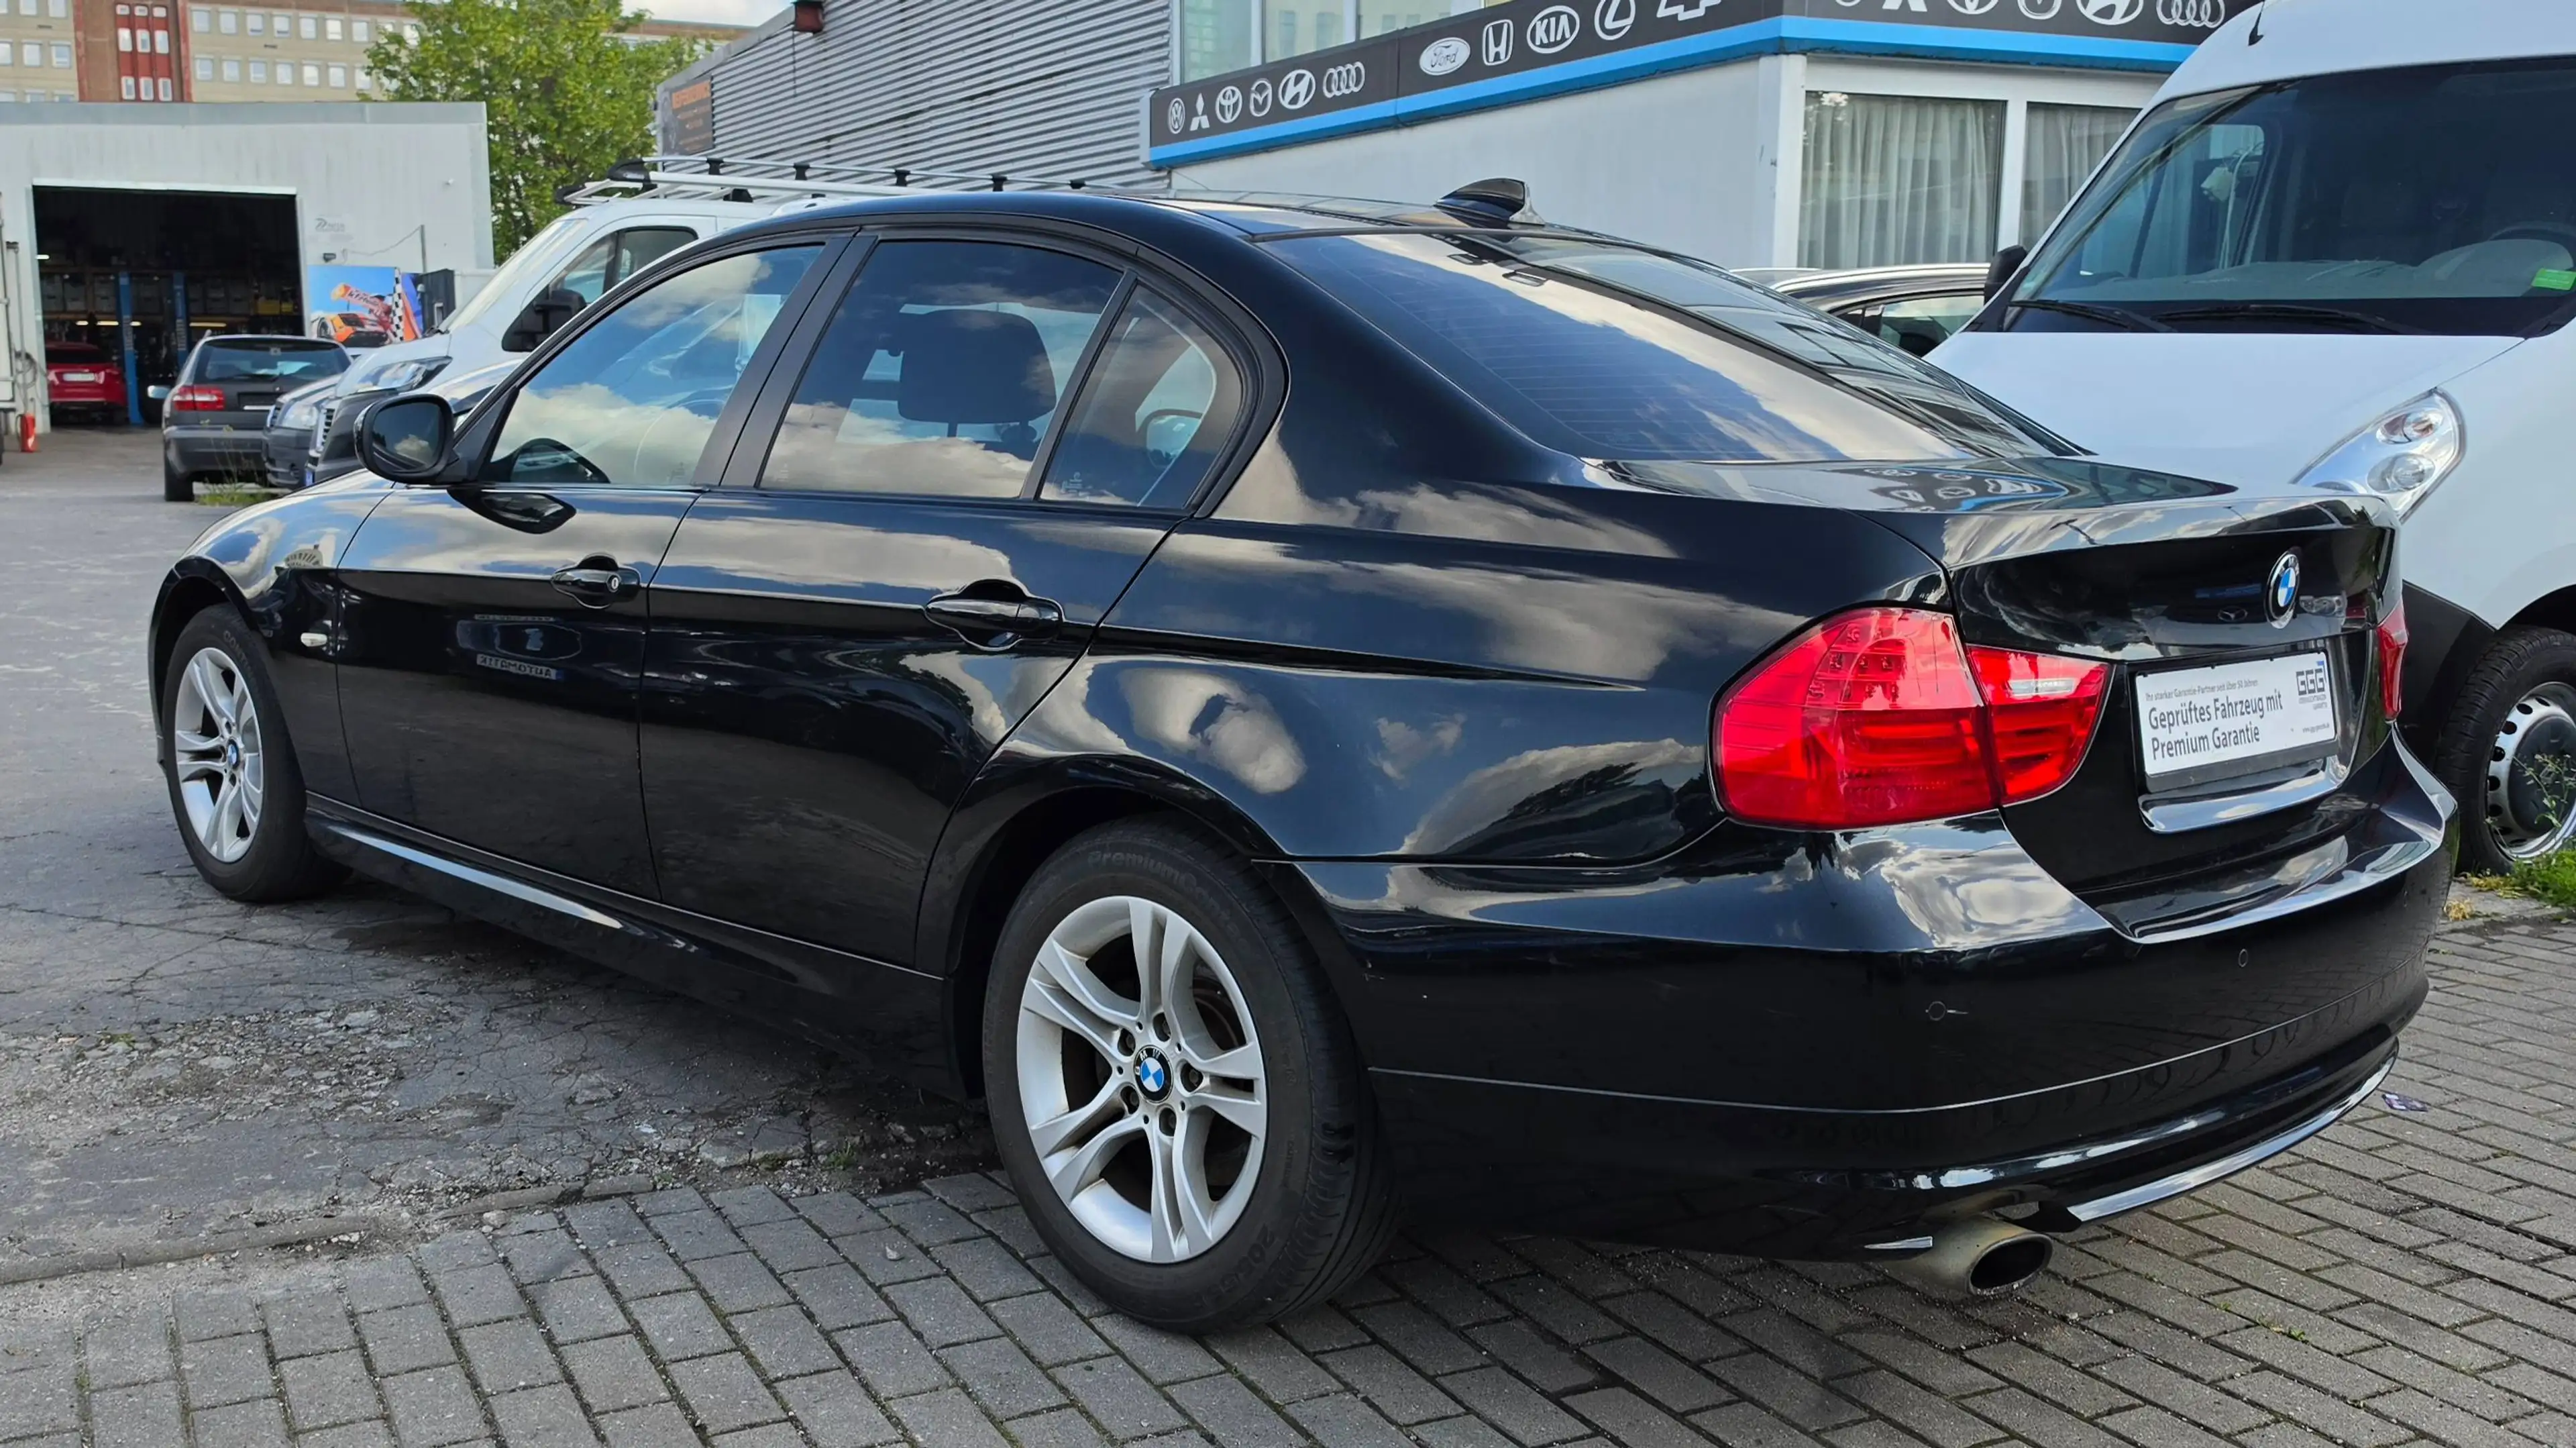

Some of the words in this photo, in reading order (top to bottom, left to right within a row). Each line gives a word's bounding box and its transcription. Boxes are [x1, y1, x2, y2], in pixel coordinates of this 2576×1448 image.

[1535, 14, 1570, 45] KIA
[1430, 44, 1459, 68] Ford
[2296, 668, 2325, 696] GGG
[2149, 701, 2212, 734] Geprüftes
[2213, 695, 2264, 719] Fahrzeug
[2265, 688, 2283, 711] mit
[2151, 731, 2210, 760] Premium
[2212, 721, 2259, 749] Garantie
[1134, 1048, 1161, 1076] BMW
